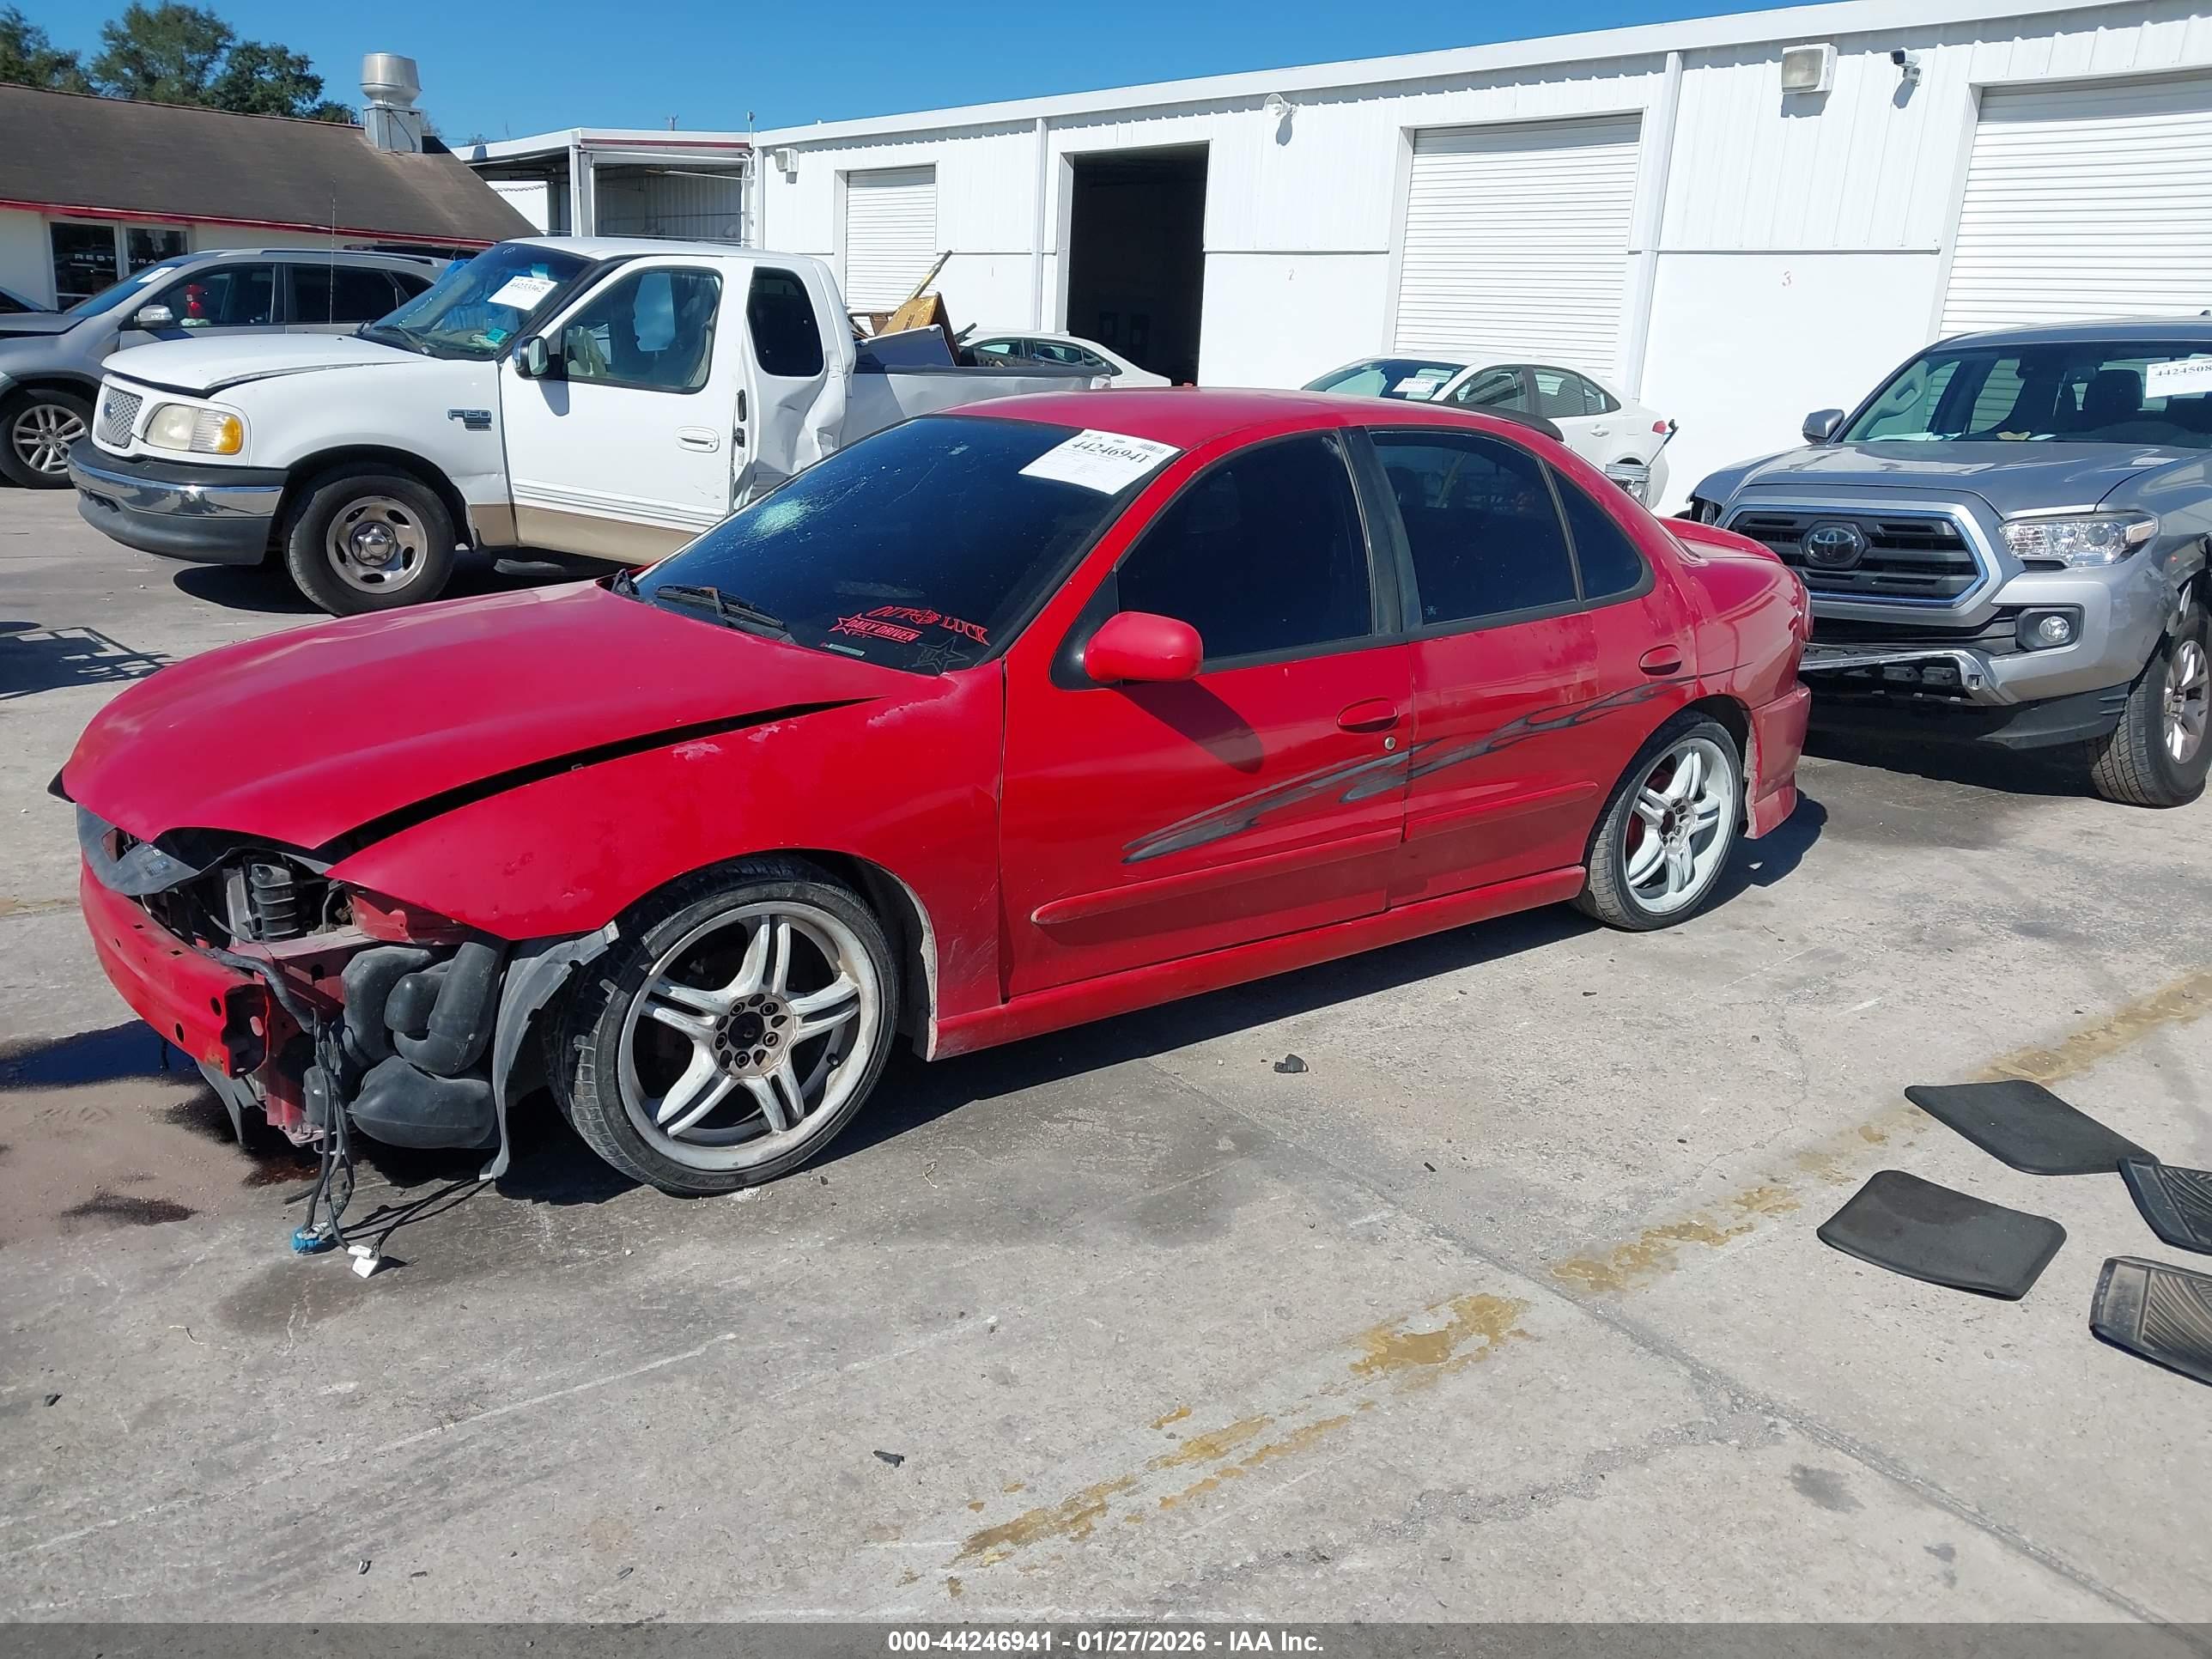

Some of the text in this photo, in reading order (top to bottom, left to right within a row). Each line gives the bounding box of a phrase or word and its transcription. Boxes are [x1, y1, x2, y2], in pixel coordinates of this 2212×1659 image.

[1781, 270, 1792, 288] 3
[1073, 441, 1150, 463] 44246941
[846, 618, 878, 635] DAILY
[874, 624, 922, 642] DRIVEN
[939, 615, 991, 647] LUCK
